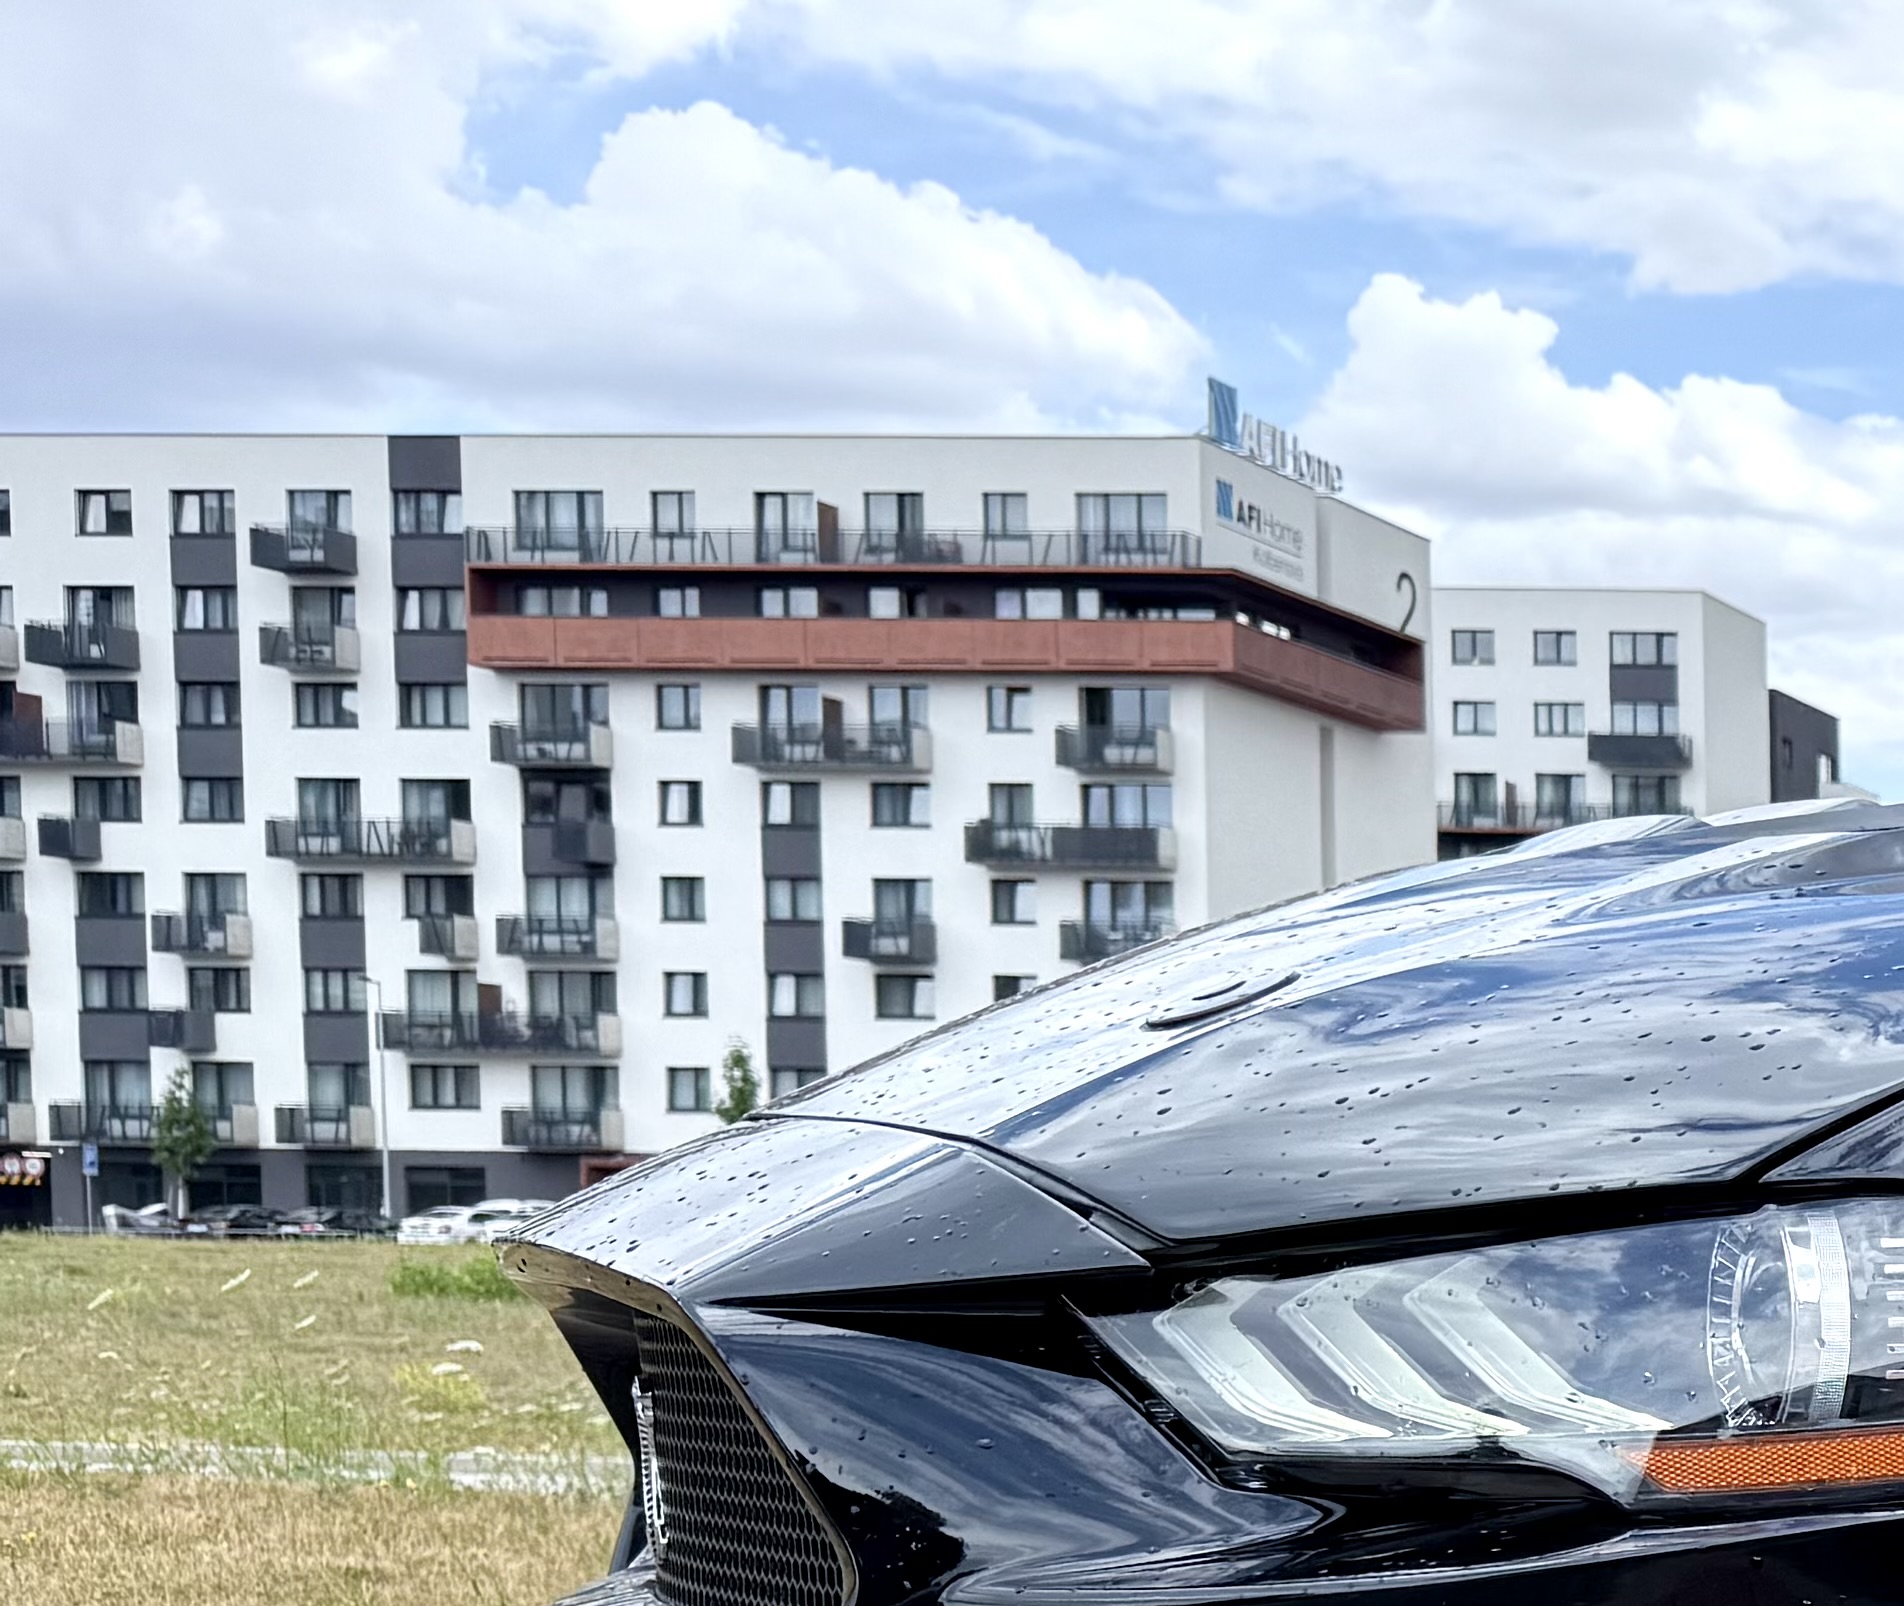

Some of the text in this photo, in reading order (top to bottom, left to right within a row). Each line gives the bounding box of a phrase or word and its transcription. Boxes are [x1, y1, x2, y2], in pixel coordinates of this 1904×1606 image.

[1241, 412, 1343, 492] AFI Home
[1236, 499, 1303, 551] AFI Home
